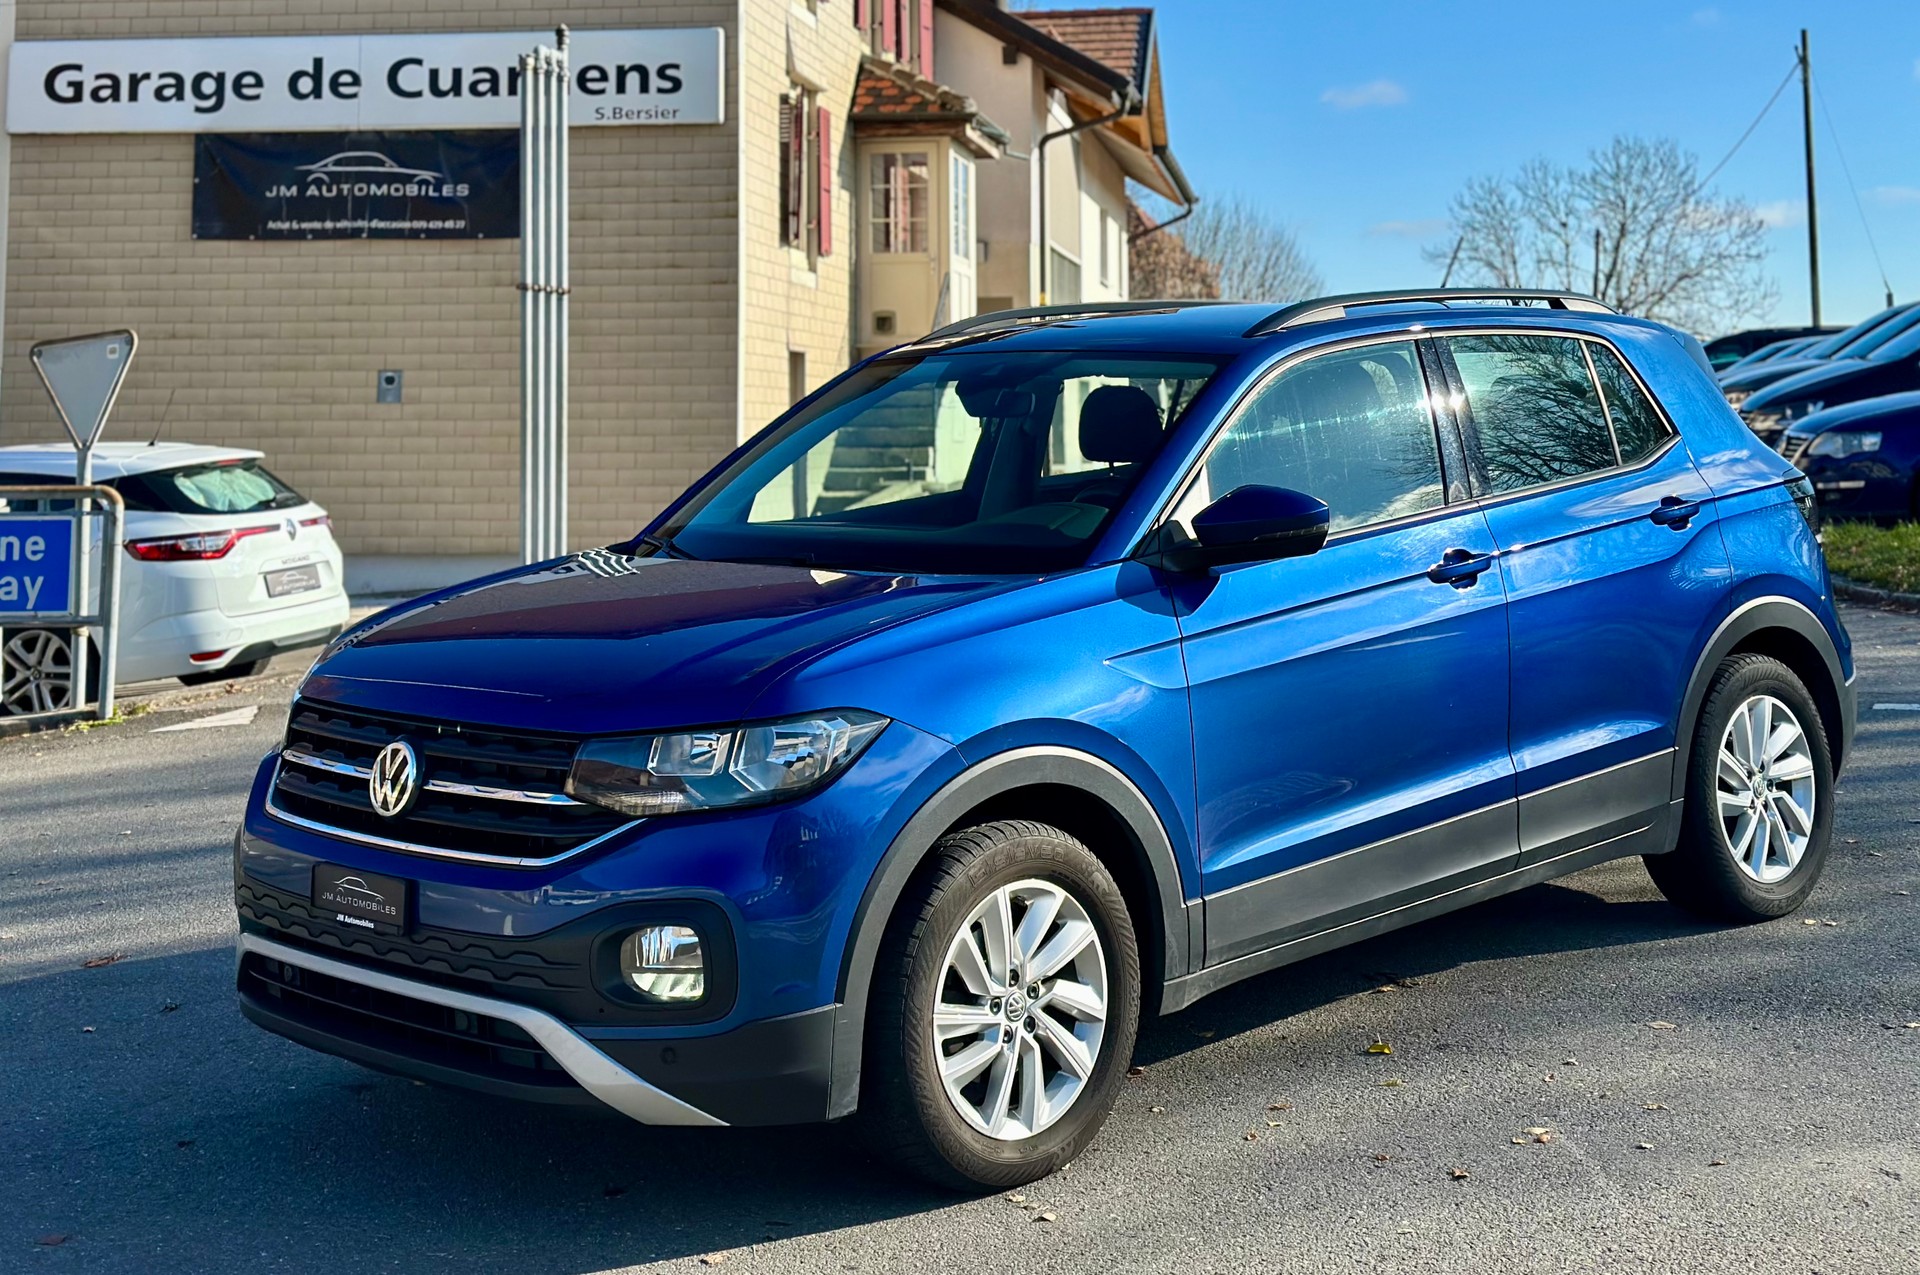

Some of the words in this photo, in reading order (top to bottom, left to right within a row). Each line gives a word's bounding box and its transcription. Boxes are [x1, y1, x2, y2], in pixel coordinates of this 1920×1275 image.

[44, 62, 264, 113] Garage
[287, 57, 362, 99] de
[386, 56, 684, 99] Cuarens
[594, 106, 680, 121] S.Bersier
[266, 184, 297, 198] JM
[306, 184, 470, 198] AUTOMOBILES
[322, 892, 334, 901] JM
[336, 895, 396, 915] AUTOMOBILES
[345, 915, 375, 929] Automobiles
